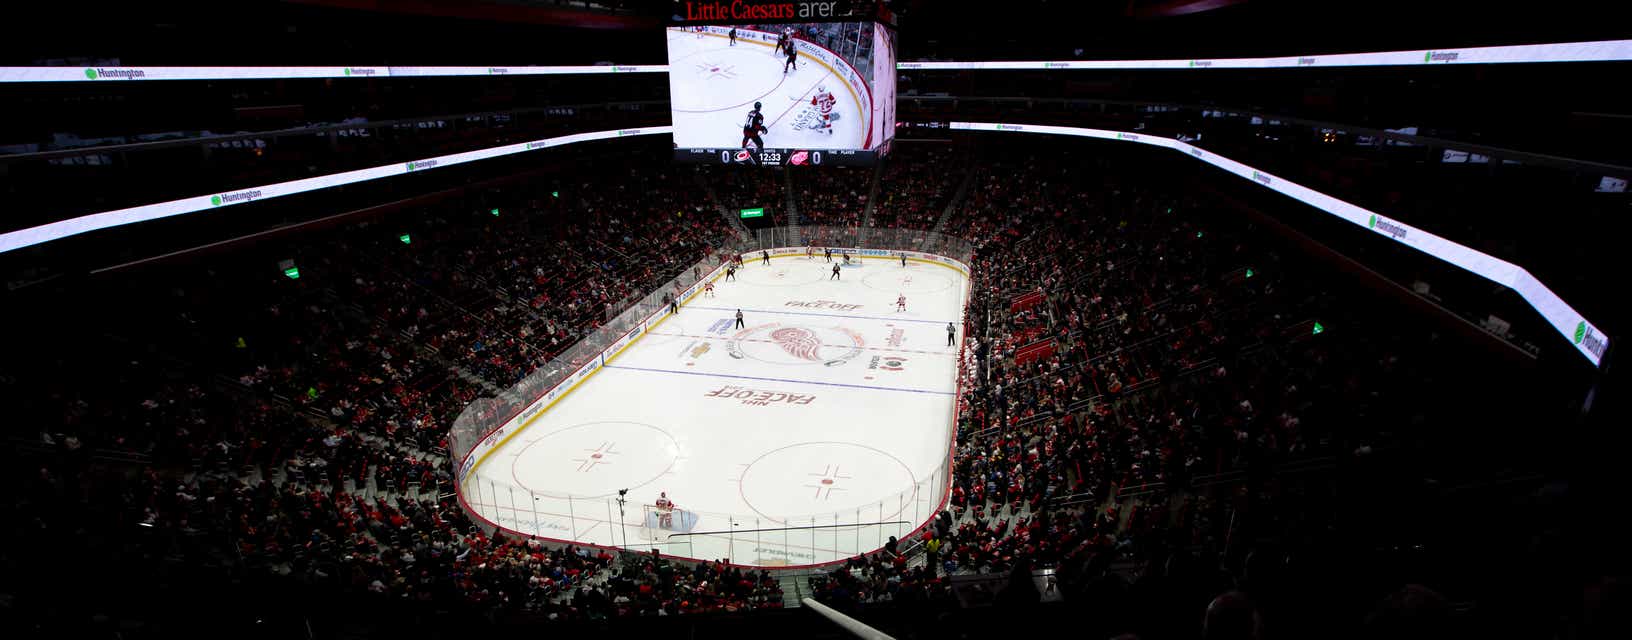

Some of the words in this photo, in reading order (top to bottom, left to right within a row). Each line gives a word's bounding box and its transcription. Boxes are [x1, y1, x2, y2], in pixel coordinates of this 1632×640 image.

[686, 2, 729, 21] Little
[731, 0, 795, 19] Caesars
[799, 2, 853, 17] are
[97, 68, 145, 80] Huntington
[721, 150, 730, 164] 0
[759, 153, 781, 161] 12:33
[812, 151, 821, 165] 0
[221, 190, 262, 203] Huntington
